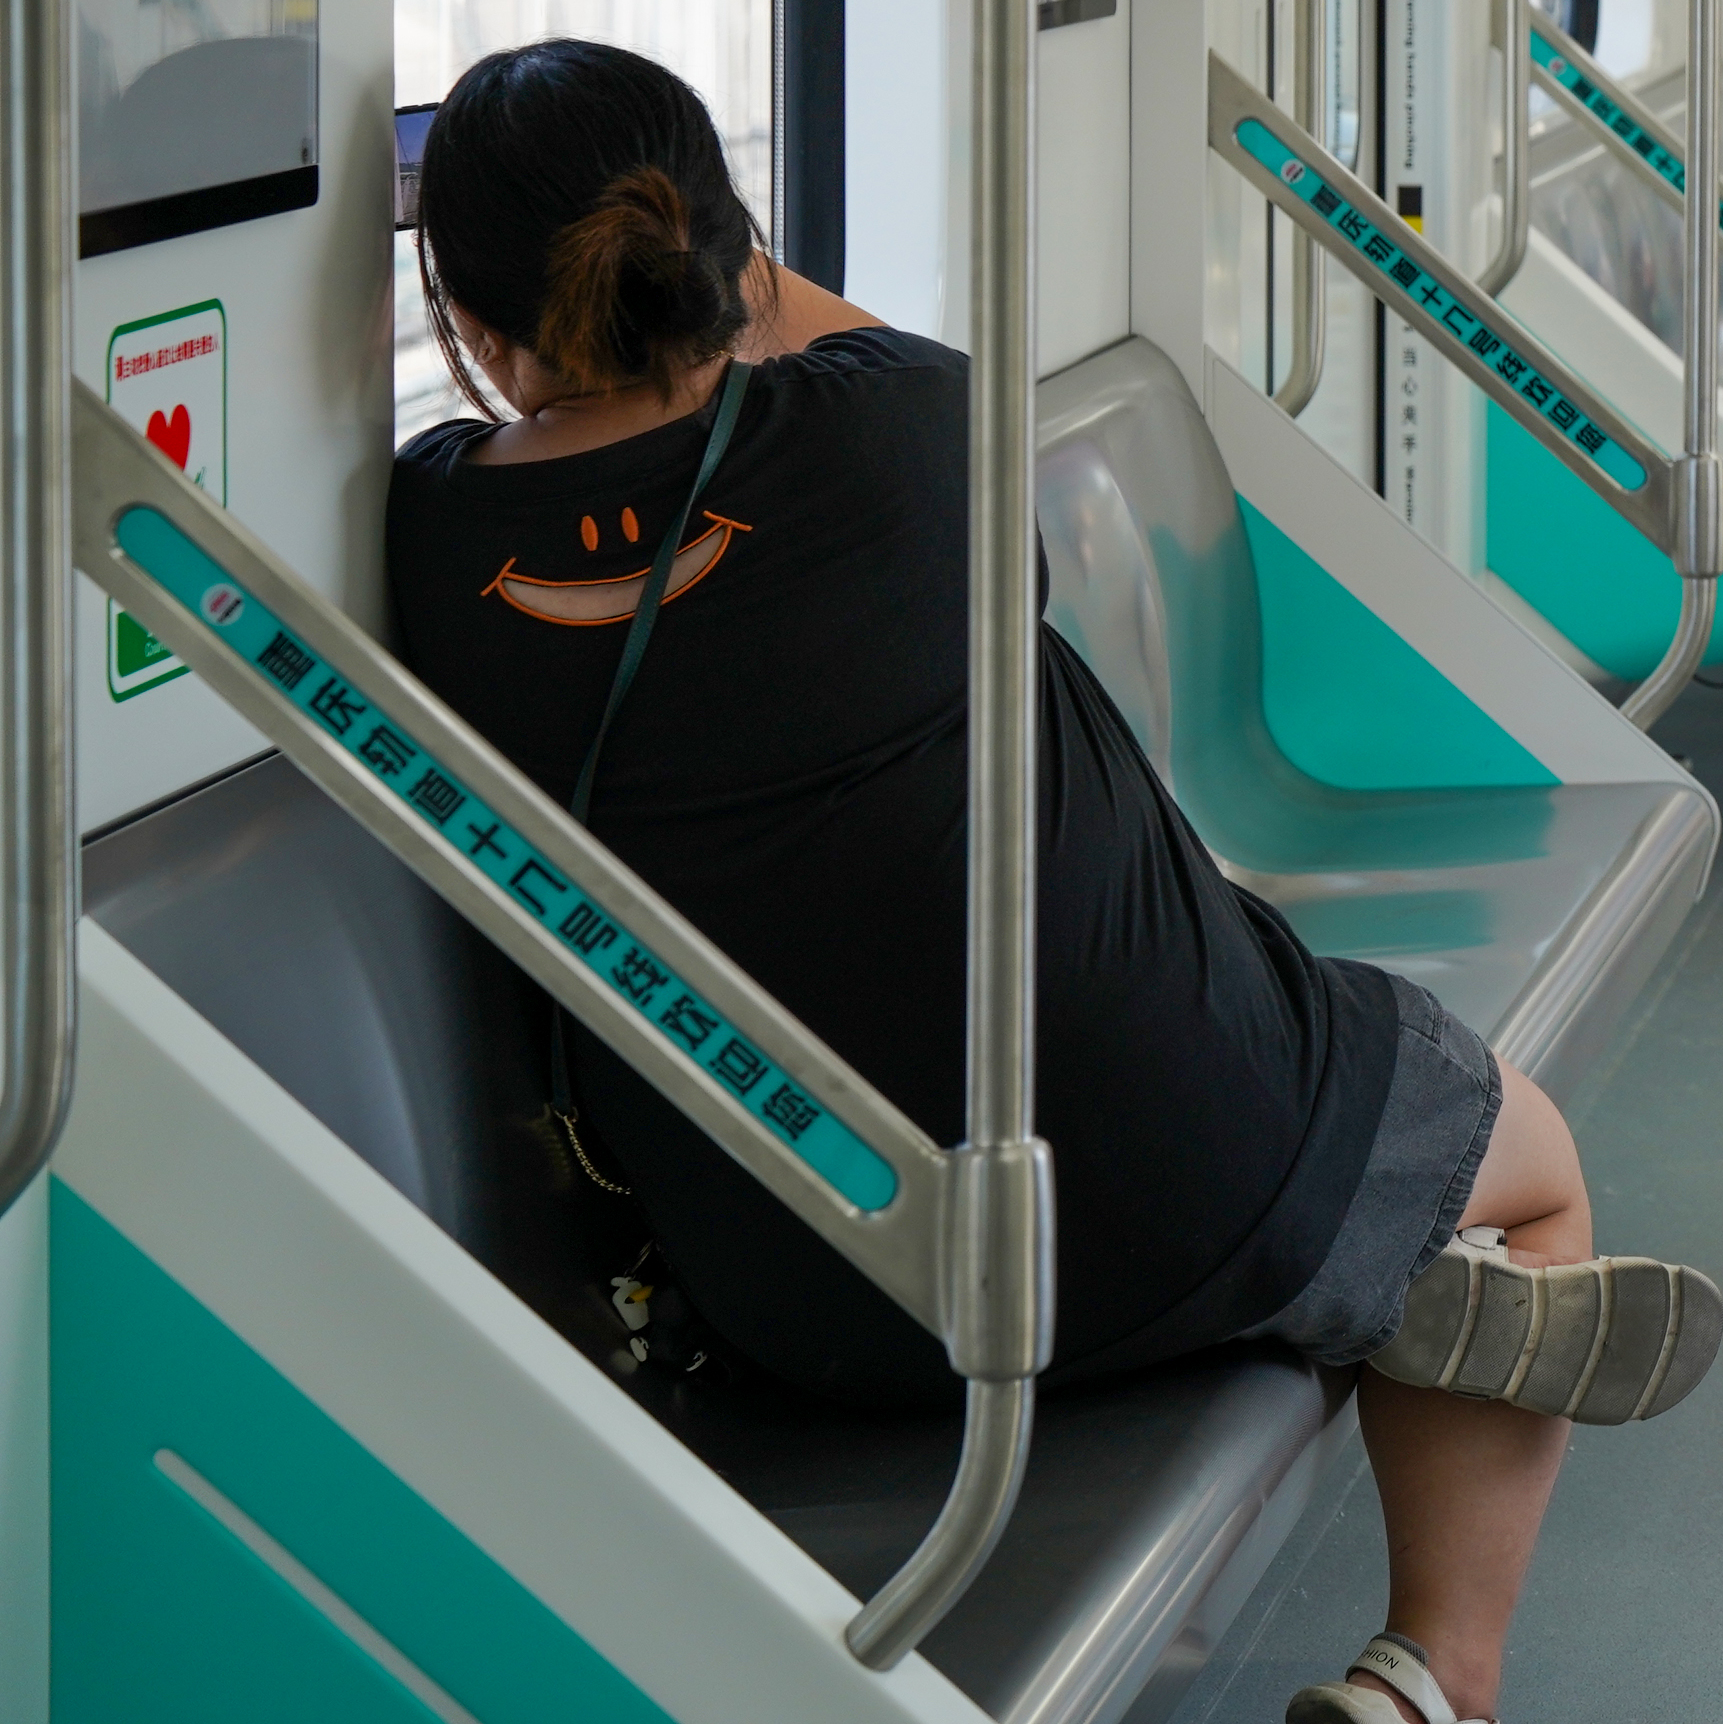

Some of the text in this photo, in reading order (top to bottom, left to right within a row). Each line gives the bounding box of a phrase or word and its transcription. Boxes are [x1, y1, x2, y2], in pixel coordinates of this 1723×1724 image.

[1311, 184, 1607, 454] 重庆轨道十八号线欢迎您
[257, 631, 821, 1141] 重庆轨道十八号线欢迎您
